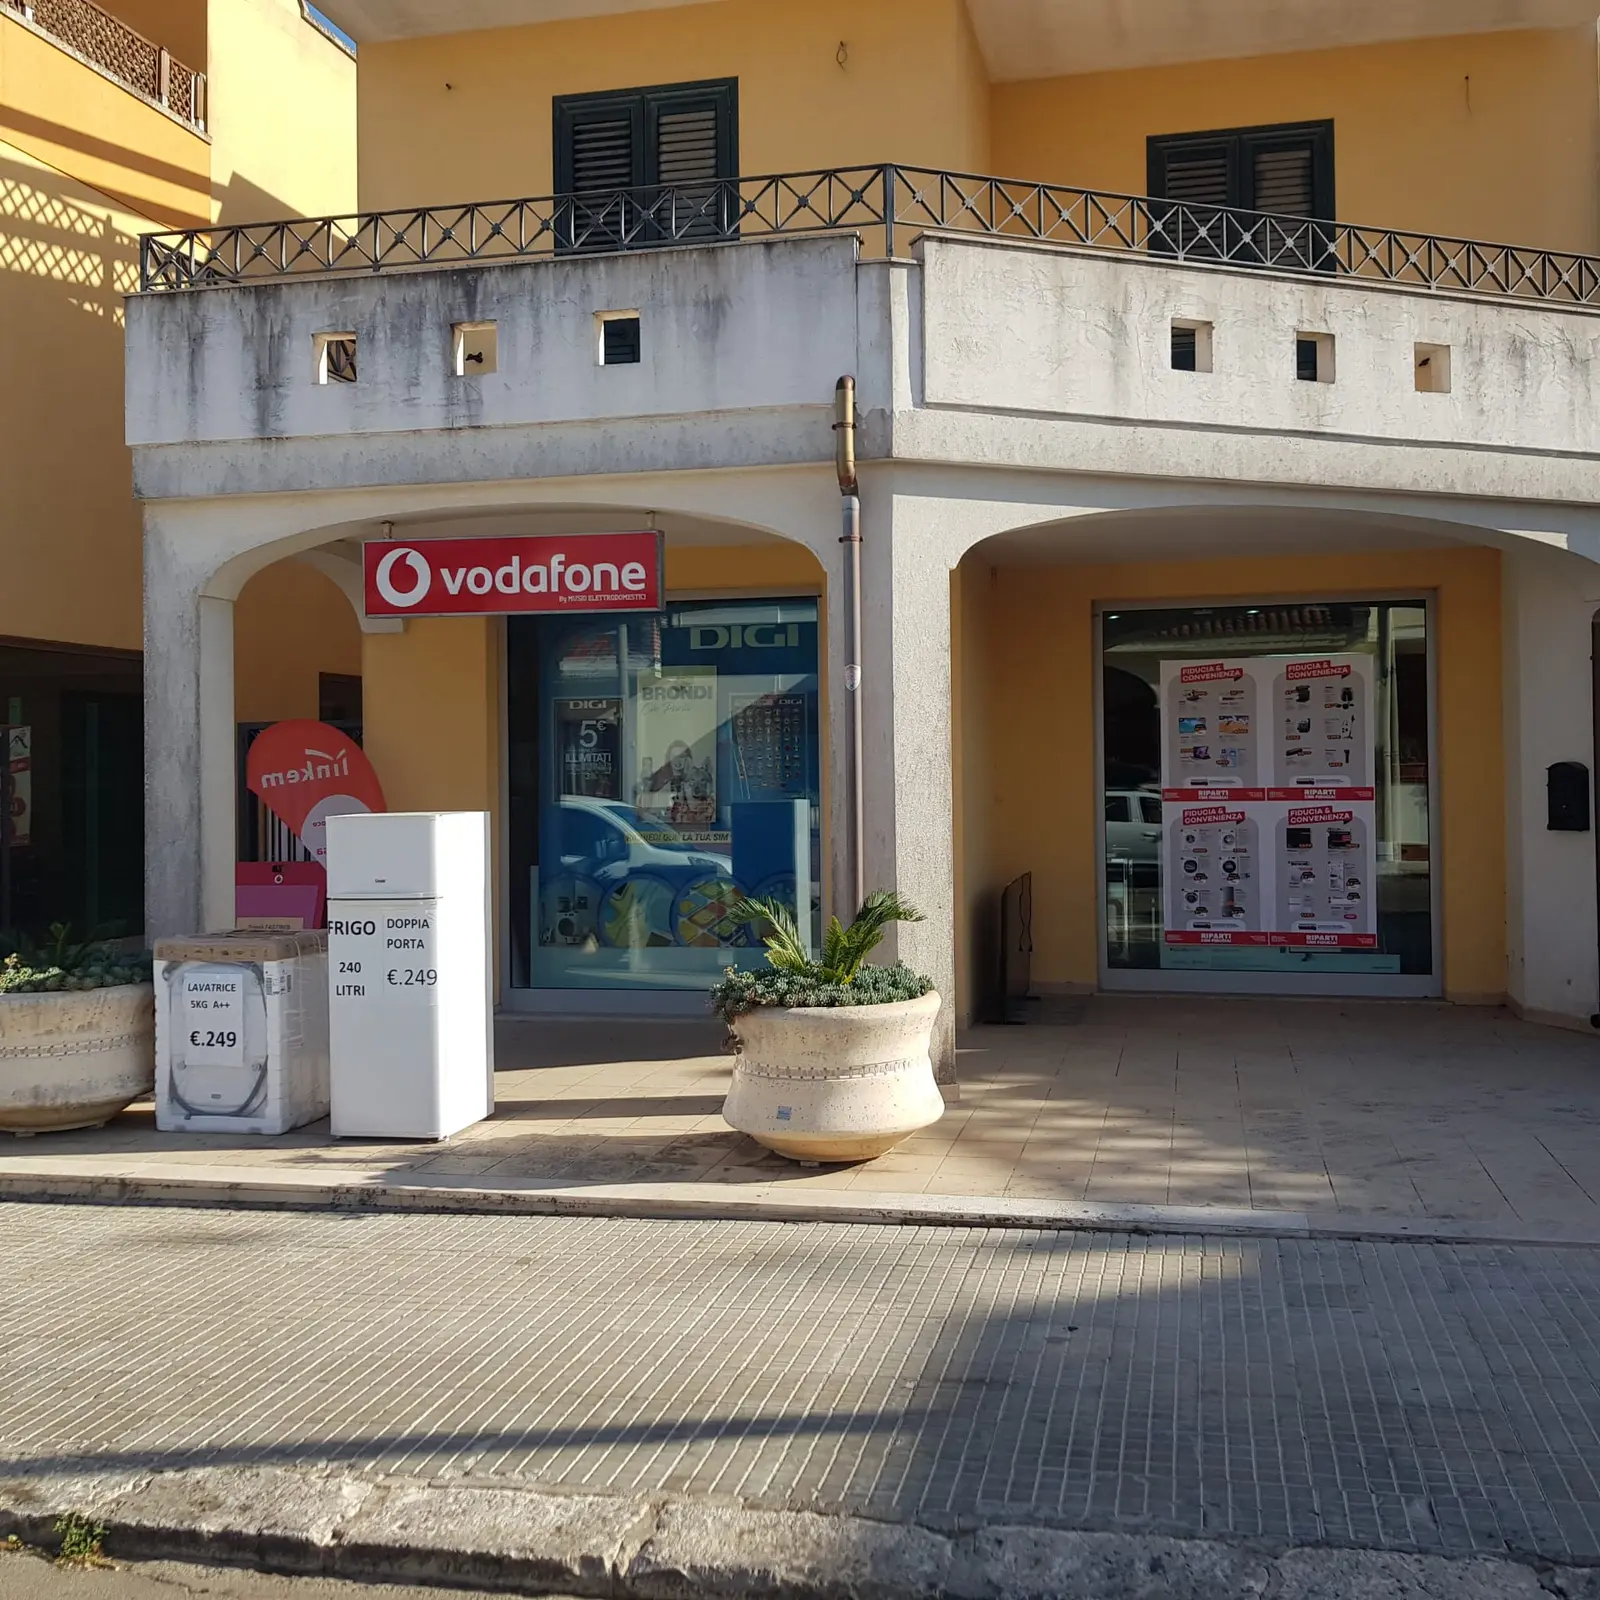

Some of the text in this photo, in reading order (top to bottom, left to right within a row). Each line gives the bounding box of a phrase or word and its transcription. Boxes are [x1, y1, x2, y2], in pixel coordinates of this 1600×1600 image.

[440, 553, 646, 595] vodafone
[690, 624, 799, 650] DIGI
[1183, 666, 1214, 675] FIDUCIA
[1288, 662, 1321, 672] FIDUCIA
[1182, 670, 1241, 682] CONVENIENZA
[1288, 667, 1349, 679] CONVENIENZA
[642, 686, 713, 700] BRONDI
[569, 700, 607, 710] DIGI
[1184, 808, 1217, 818] FIDUCIA
[1290, 807, 1323, 817] FIDUCIA
[1184, 813, 1243, 825] CONVENIENZA
[1290, 812, 1351, 824] CONVENIENZA
[695, 833, 711, 841] TUA
[713, 833, 729, 841] SIM
[328, 921, 376, 936] FRIGO
[387, 918, 430, 929] DOPPIA
[387, 938, 425, 949] PORTA
[339, 962, 362, 973] 240
[387, 969, 438, 986] €.249
[188, 983, 236, 992] LAVATRICE
[336, 985, 365, 996] LITRI
[191, 1000, 230, 1009] 5KG A++
[190, 1031, 237, 1048] €.249
